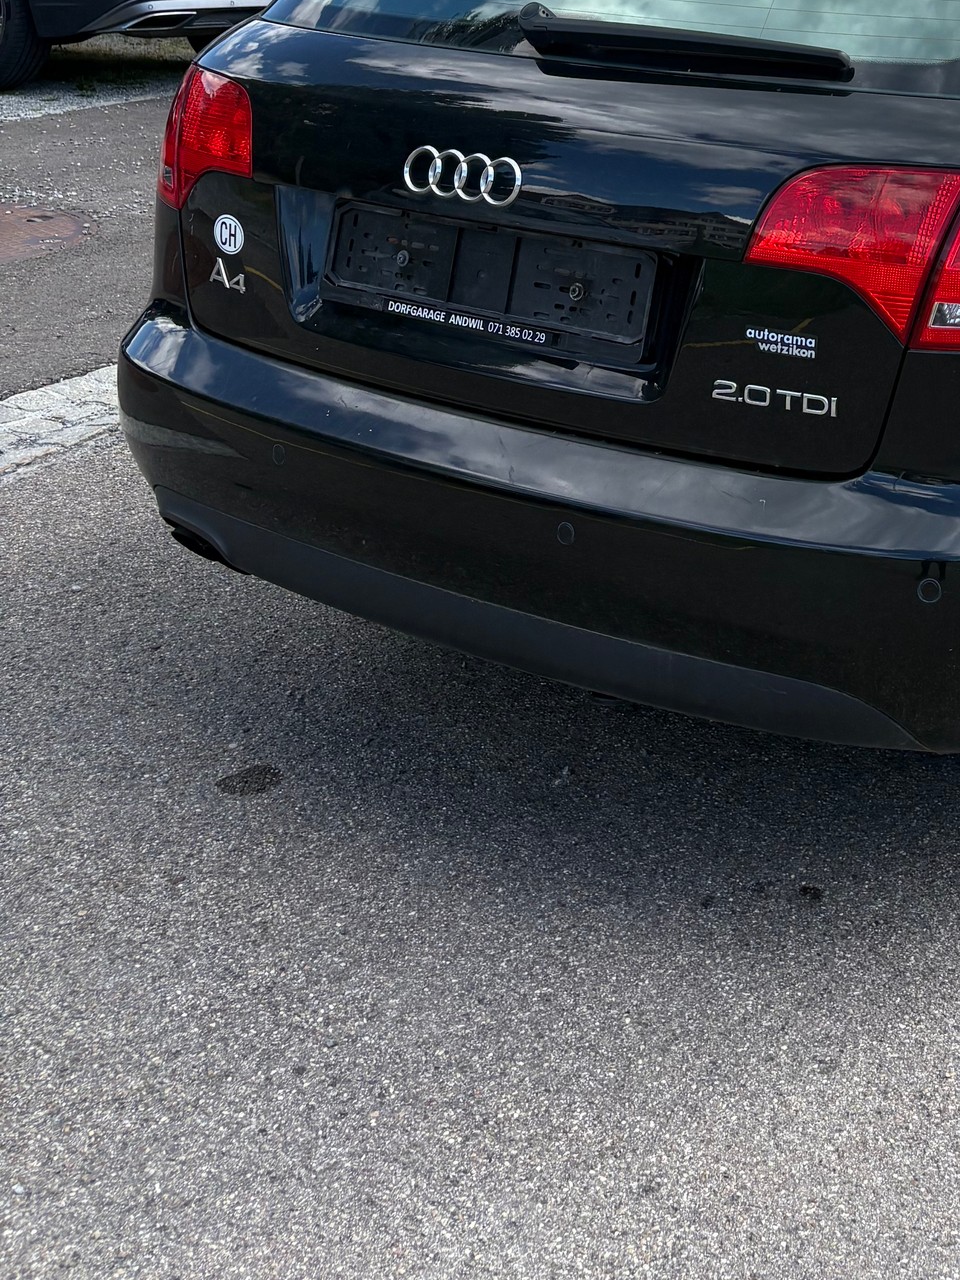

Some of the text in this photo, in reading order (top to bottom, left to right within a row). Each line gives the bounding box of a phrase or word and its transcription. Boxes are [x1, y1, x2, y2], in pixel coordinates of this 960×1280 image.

[220, 221, 237, 248] CH
[209, 256, 246, 294] A4
[388, 301, 546, 344] DORFGARAGE ANDWIL 071 385 02 29
[746, 328, 816, 348] autorama
[758, 342, 816, 359] wetzikon
[712, 379, 838, 417] 2.0 TDI
